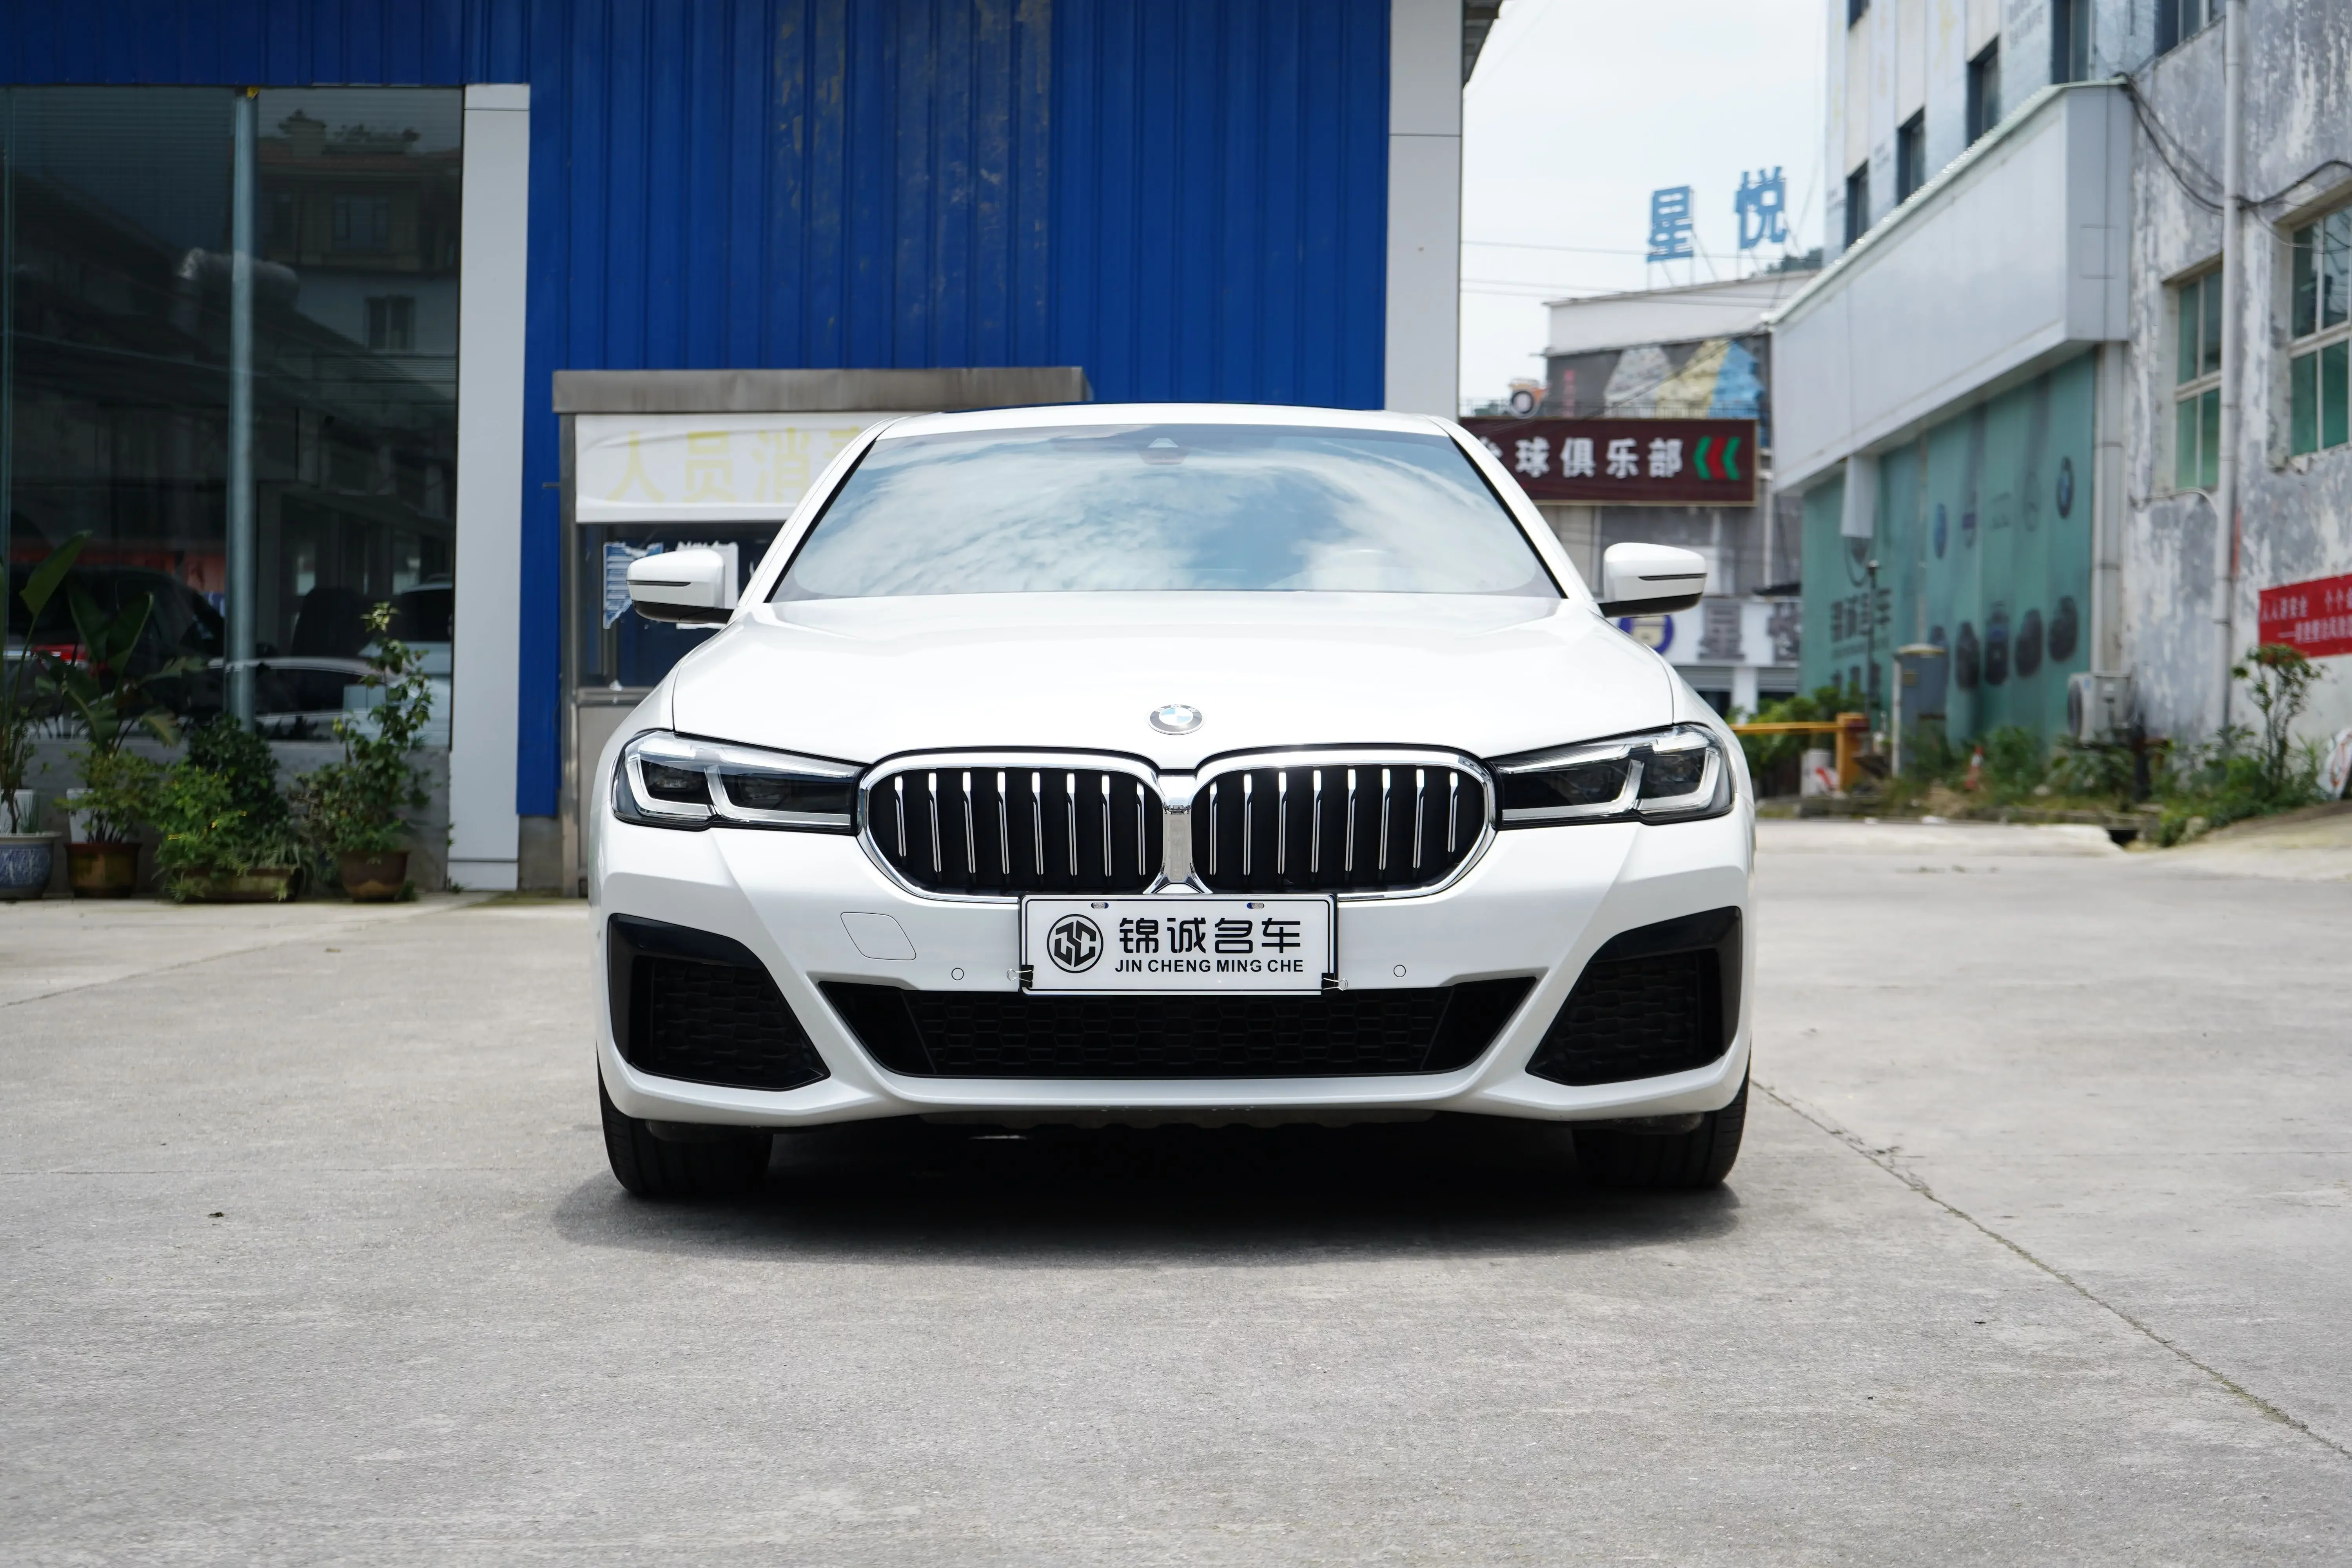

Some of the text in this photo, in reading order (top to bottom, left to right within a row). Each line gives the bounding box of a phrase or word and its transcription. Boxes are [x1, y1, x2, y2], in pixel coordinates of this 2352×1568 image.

[1119, 917, 1301, 954] 锦诚名车
[1115, 959, 1303, 972] JIN CHENG MING CHE
